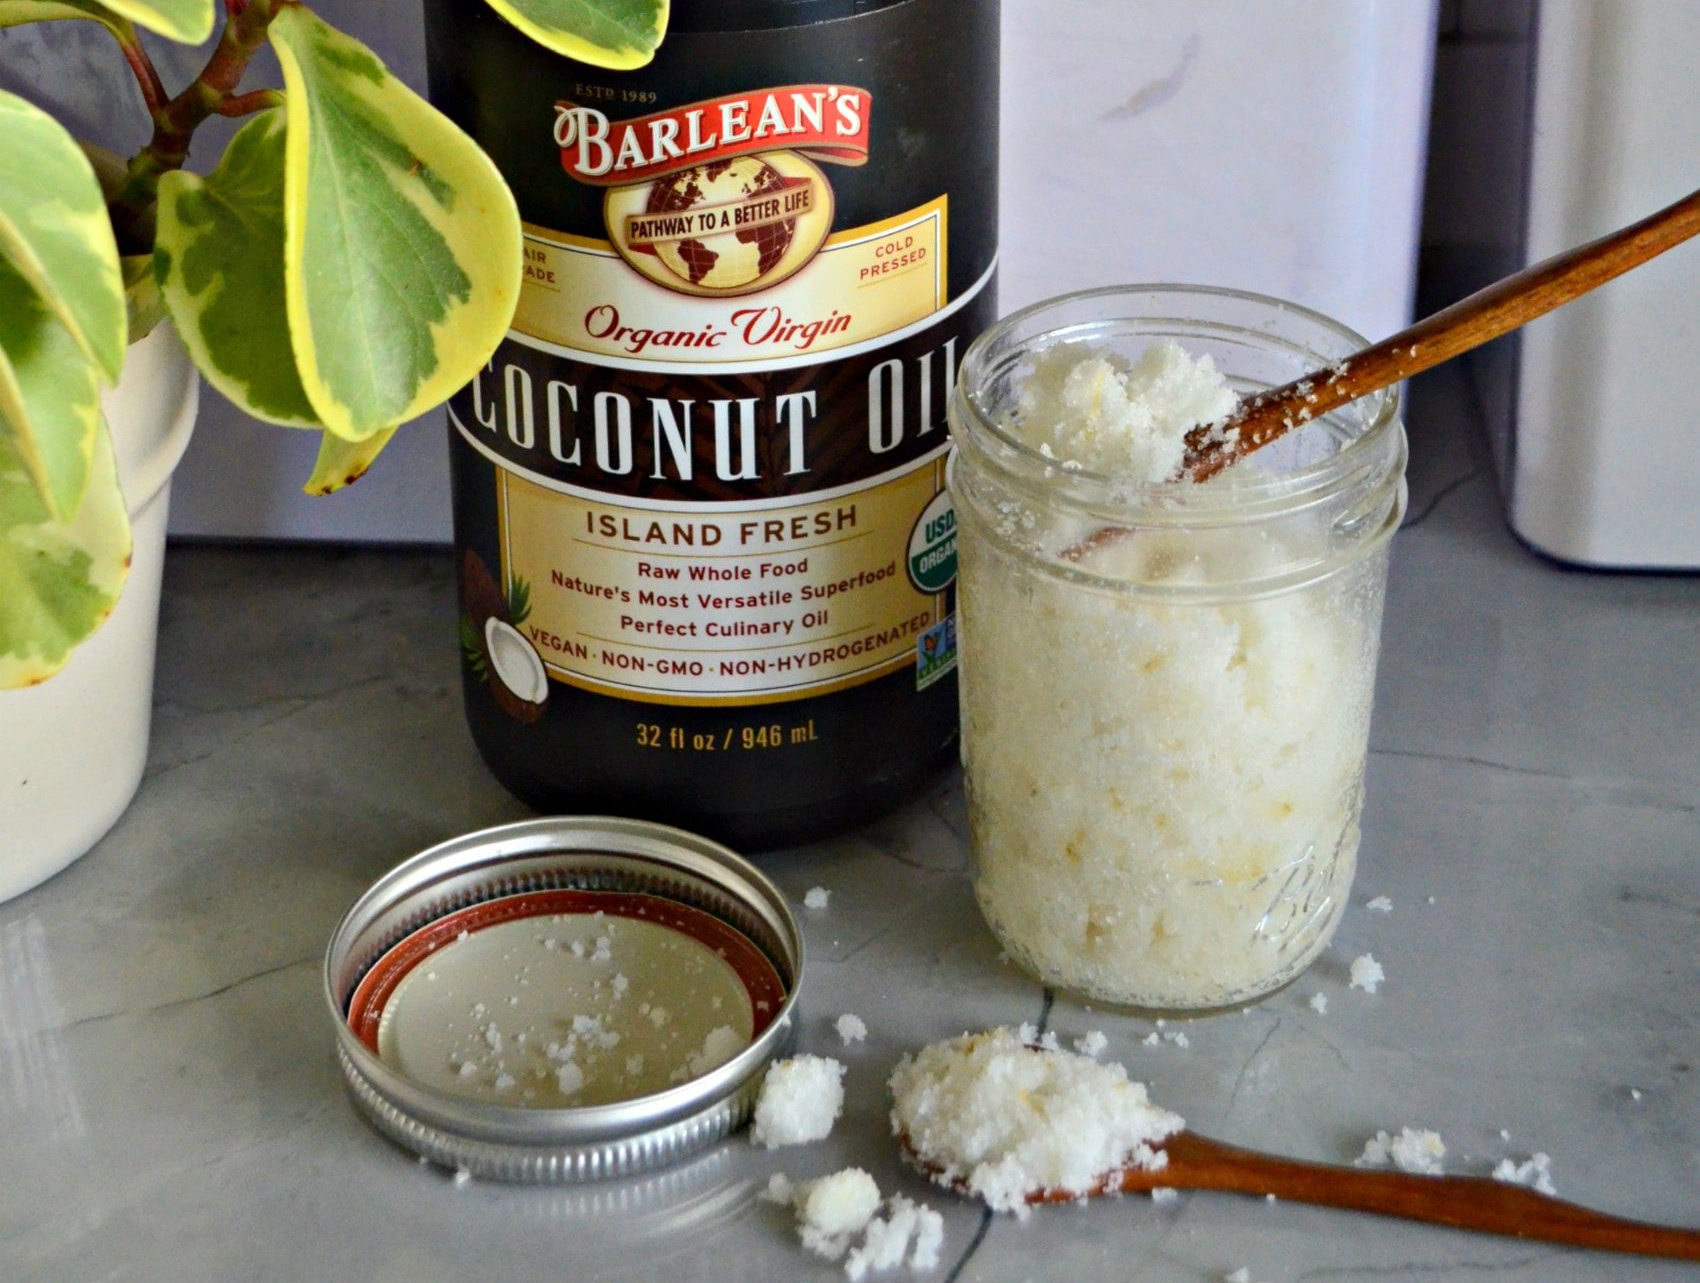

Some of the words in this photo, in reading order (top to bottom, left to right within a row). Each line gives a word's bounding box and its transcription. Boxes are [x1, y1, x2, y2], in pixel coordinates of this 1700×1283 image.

[622, 90, 657, 104] 1989
[553, 87, 861, 176] BARLEAN'S
[631, 215, 694, 239] PATHWAY
[698, 213, 716, 231] TO
[721, 210, 730, 227] A
[734, 199, 780, 226] BETTER
[785, 190, 809, 213] LIFE
[523, 247, 546, 264] AIR
[860, 247, 927, 280] PRESSED
[875, 236, 913, 258] COLD
[526, 265, 556, 283] ADE
[584, 304, 727, 353] Organic
[731, 306, 851, 349] Virgin
[587, 511, 722, 546] ISLAND
[740, 505, 856, 545] FRESH
[926, 508, 957, 543] USD
[551, 569, 631, 603] Nature's
[638, 590, 689, 609] Most
[698, 590, 792, 609] Versatile
[801, 561, 896, 599] Superfood
[638, 562, 680, 580] Raw
[688, 565, 752, 581] Whole
[760, 558, 808, 578] Food
[621, 616, 697, 637] Perfect
[705, 618, 794, 637] Culinary
[802, 610, 828, 628] Oil
[530, 625, 587, 659] VEGAN
[602, 650, 703, 676] NON-GMO
[720, 612, 930, 676] NON-HYDROGENATED
[636, 723, 661, 747] 32
[670, 727, 685, 749] fl
[693, 733, 715, 750] oz
[723, 728, 733, 750] /
[742, 724, 781, 749] 946
[790, 719, 818, 743] mL
